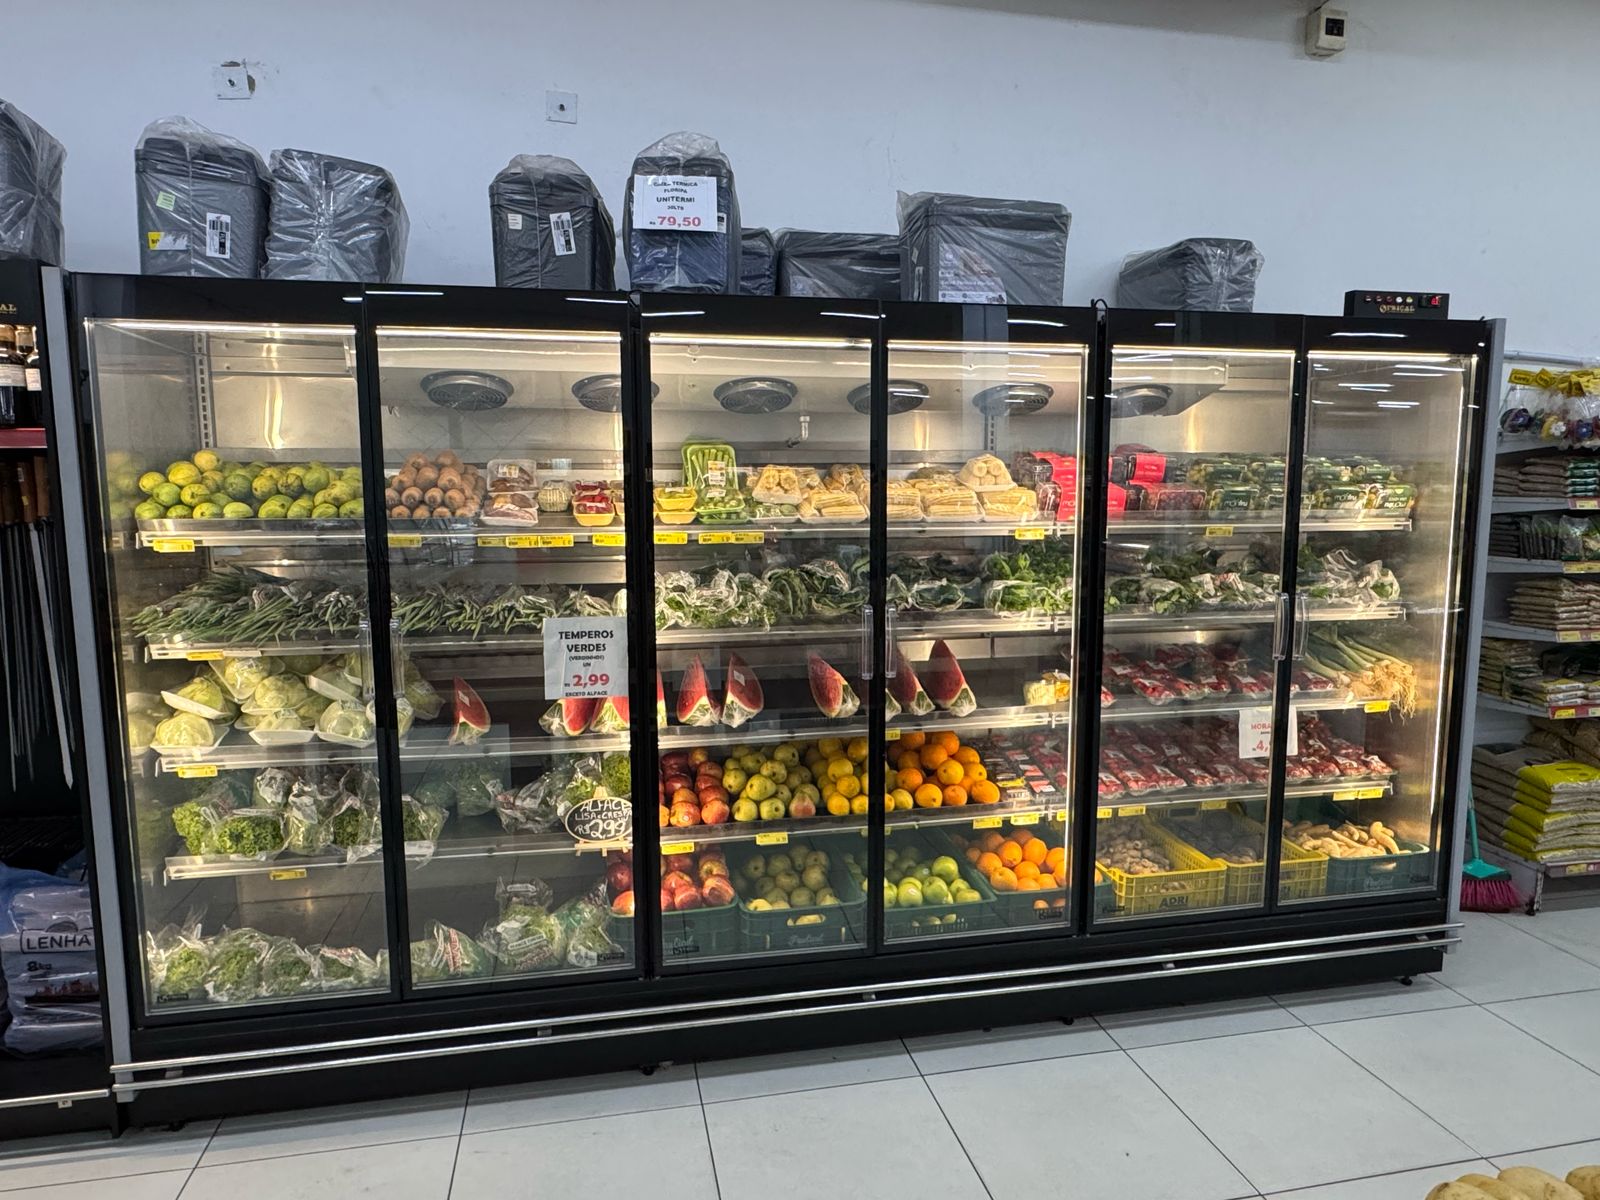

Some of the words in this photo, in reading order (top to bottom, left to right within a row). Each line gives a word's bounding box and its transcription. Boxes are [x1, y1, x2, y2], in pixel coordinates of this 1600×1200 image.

[657, 216, 701, 228] 79,50
[558, 630, 614, 640] TEMPEROS
[566, 643, 607, 652] VERDES
[572, 673, 610, 688] 2,99
[1256, 740, 1268, 752] 4,
[580, 800, 632, 812] ALFACE
[26, 934, 91, 950] LENHA
